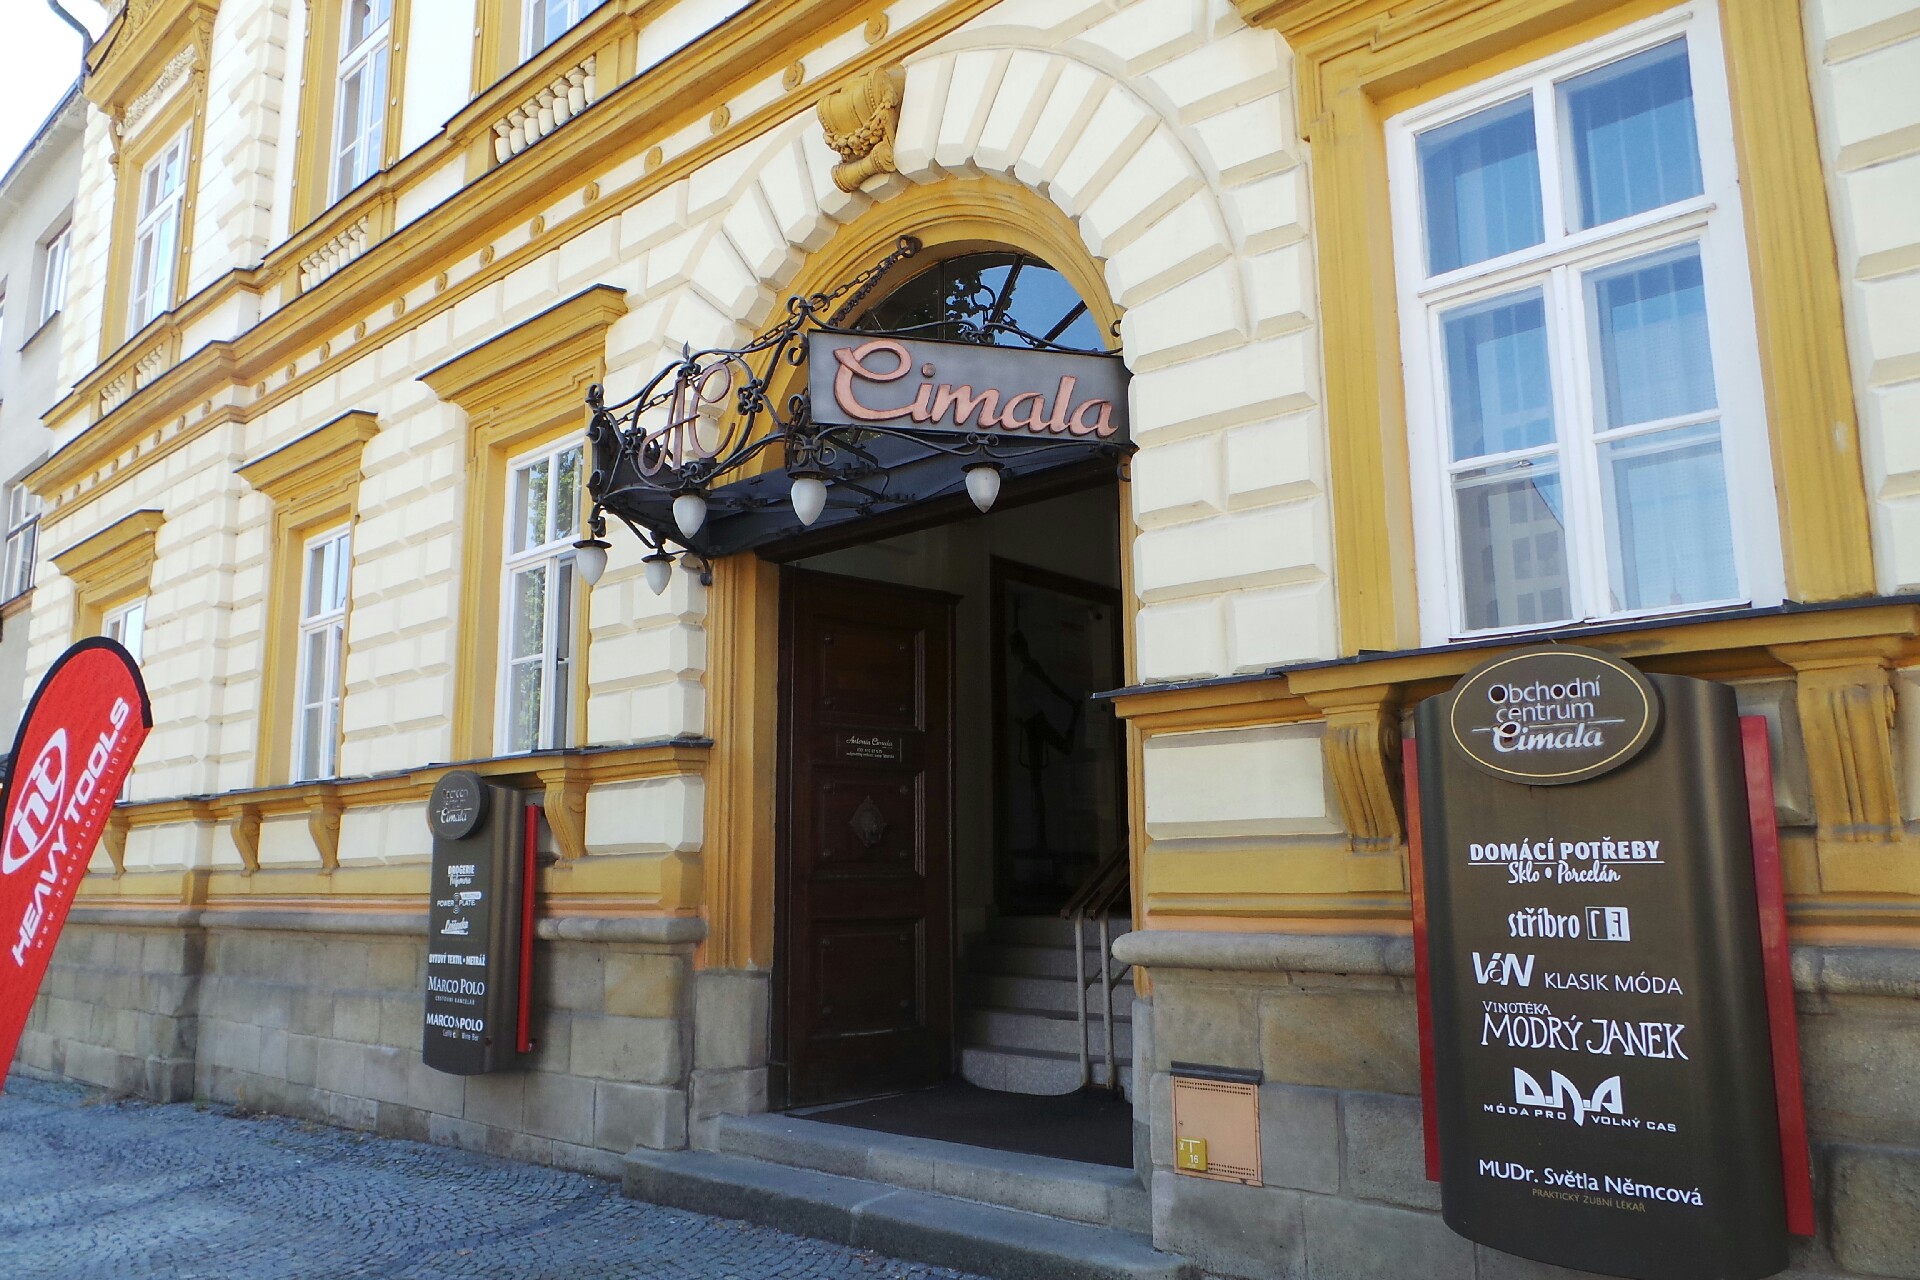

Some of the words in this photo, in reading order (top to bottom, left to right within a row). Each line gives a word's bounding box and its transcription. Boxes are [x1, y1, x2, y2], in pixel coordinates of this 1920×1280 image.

[833, 340, 1118, 437] Cimala
[1488, 675, 1601, 704] Obchodní
[1496, 702, 1594, 723] centrum
[1492, 721, 1605, 752] Cimala
[12, 823, 68, 967] HEAVY
[63, 697, 129, 824] TOOLS
[1469, 837, 1554, 861] DOMÁCÍ
[1560, 836, 1660, 860] POTŘEBY
[1508, 861, 1540, 884] Sklo
[1557, 860, 1621, 884] Porcelán
[1508, 907, 1580, 939] stříbro
[428, 976, 459, 993] MARCO
[460, 979, 485, 996] POLO
[1544, 973, 1609, 991] KLASIK
[1614, 971, 1683, 995] MÓDA
[1482, 1001, 1551, 1015] VINOTÉKA
[426, 1013, 455, 1028] MARCO
[460, 1017, 483, 1031] POLO
[1481, 1013, 1583, 1050] MODRÝ
[1586, 1018, 1689, 1060] JANEK
[1483, 1103, 1529, 1116] MÓDA
[1534, 1109, 1567, 1121] PRO
[1591, 1114, 1641, 1128] VOLNÝ
[1189, 1154, 1199, 1164] 16
[1479, 1159, 1539, 1184] MUDr.
[1544, 1167, 1599, 1191] Světla
[1604, 1175, 1704, 1206] Němcová
[1532, 1188, 1581, 1203] PRAKTICKÝ
[1583, 1194, 1613, 1208] ZUBNÍ
